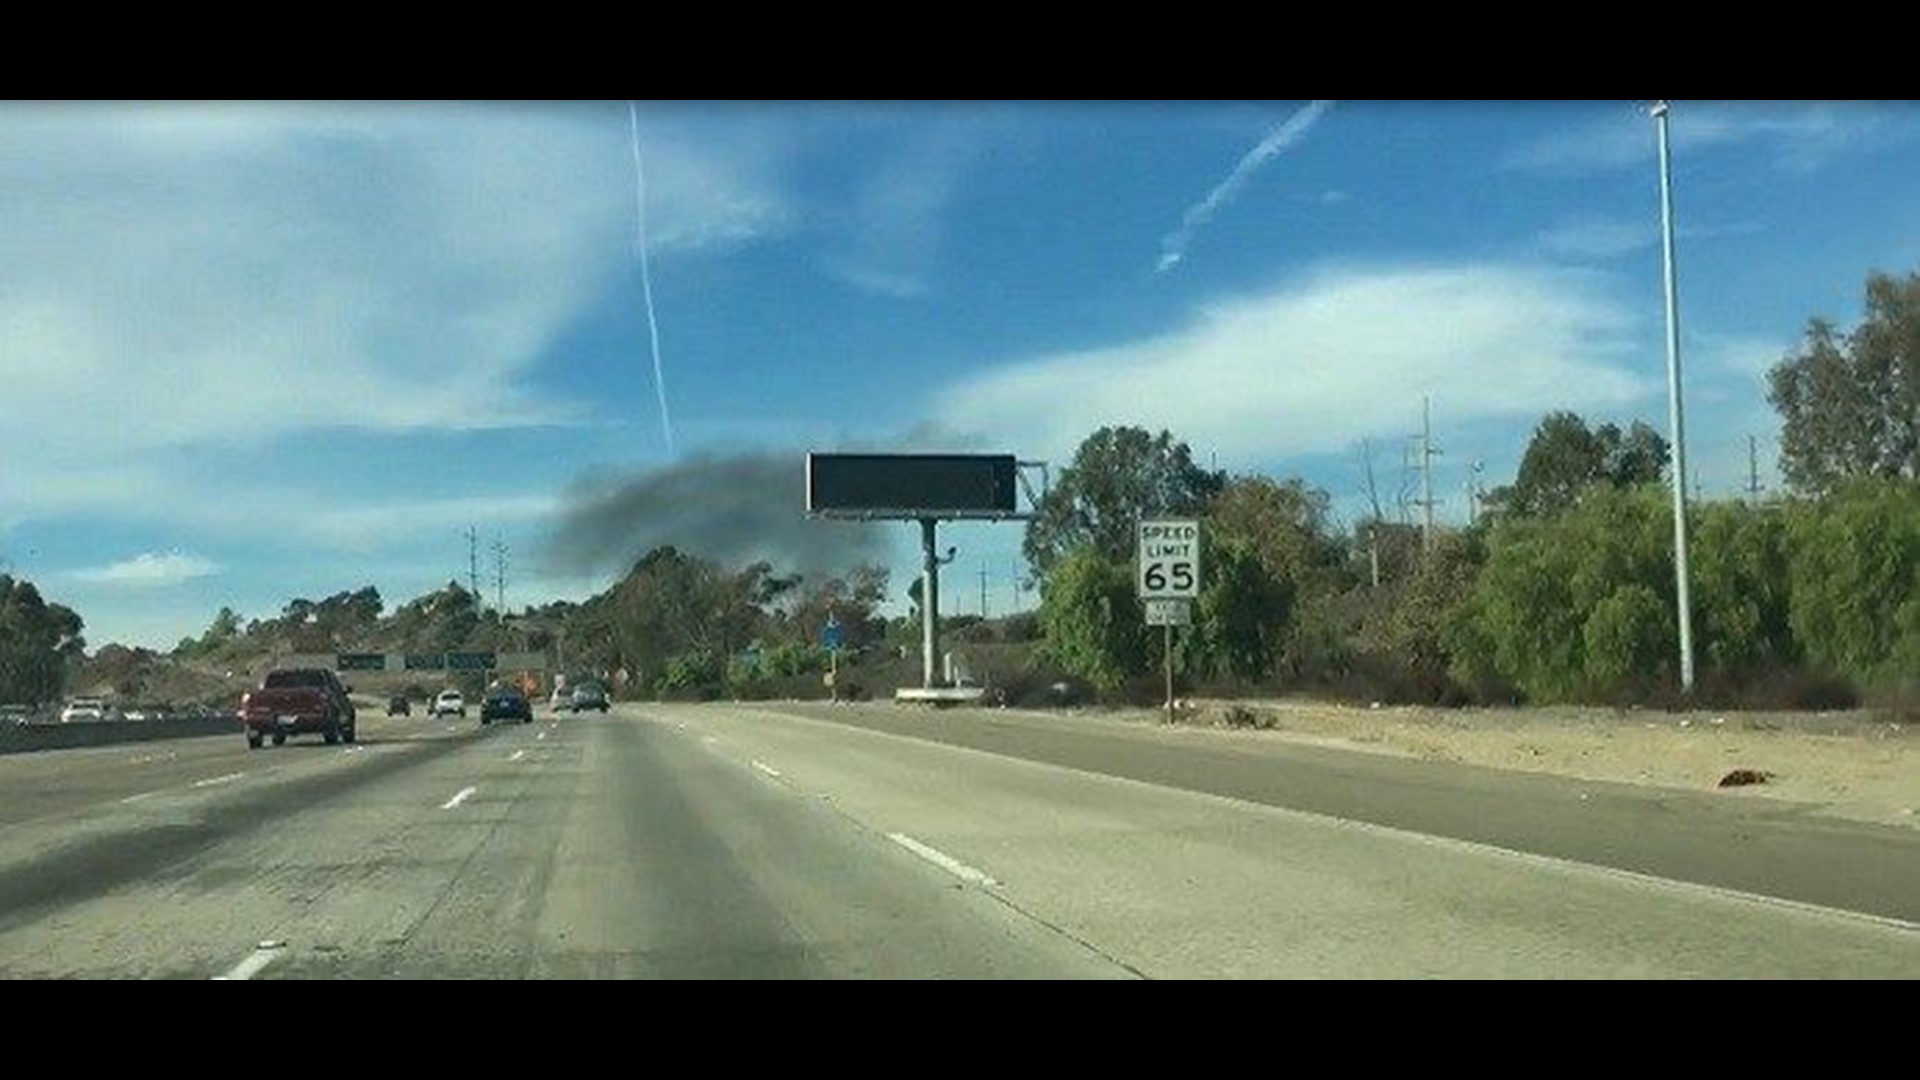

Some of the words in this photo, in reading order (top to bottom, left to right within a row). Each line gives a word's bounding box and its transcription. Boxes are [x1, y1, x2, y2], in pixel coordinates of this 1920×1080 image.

[1142, 526, 1196, 540] SPEED
[1147, 545, 1190, 558] LIMIT
[1145, 562, 1193, 590] 65
